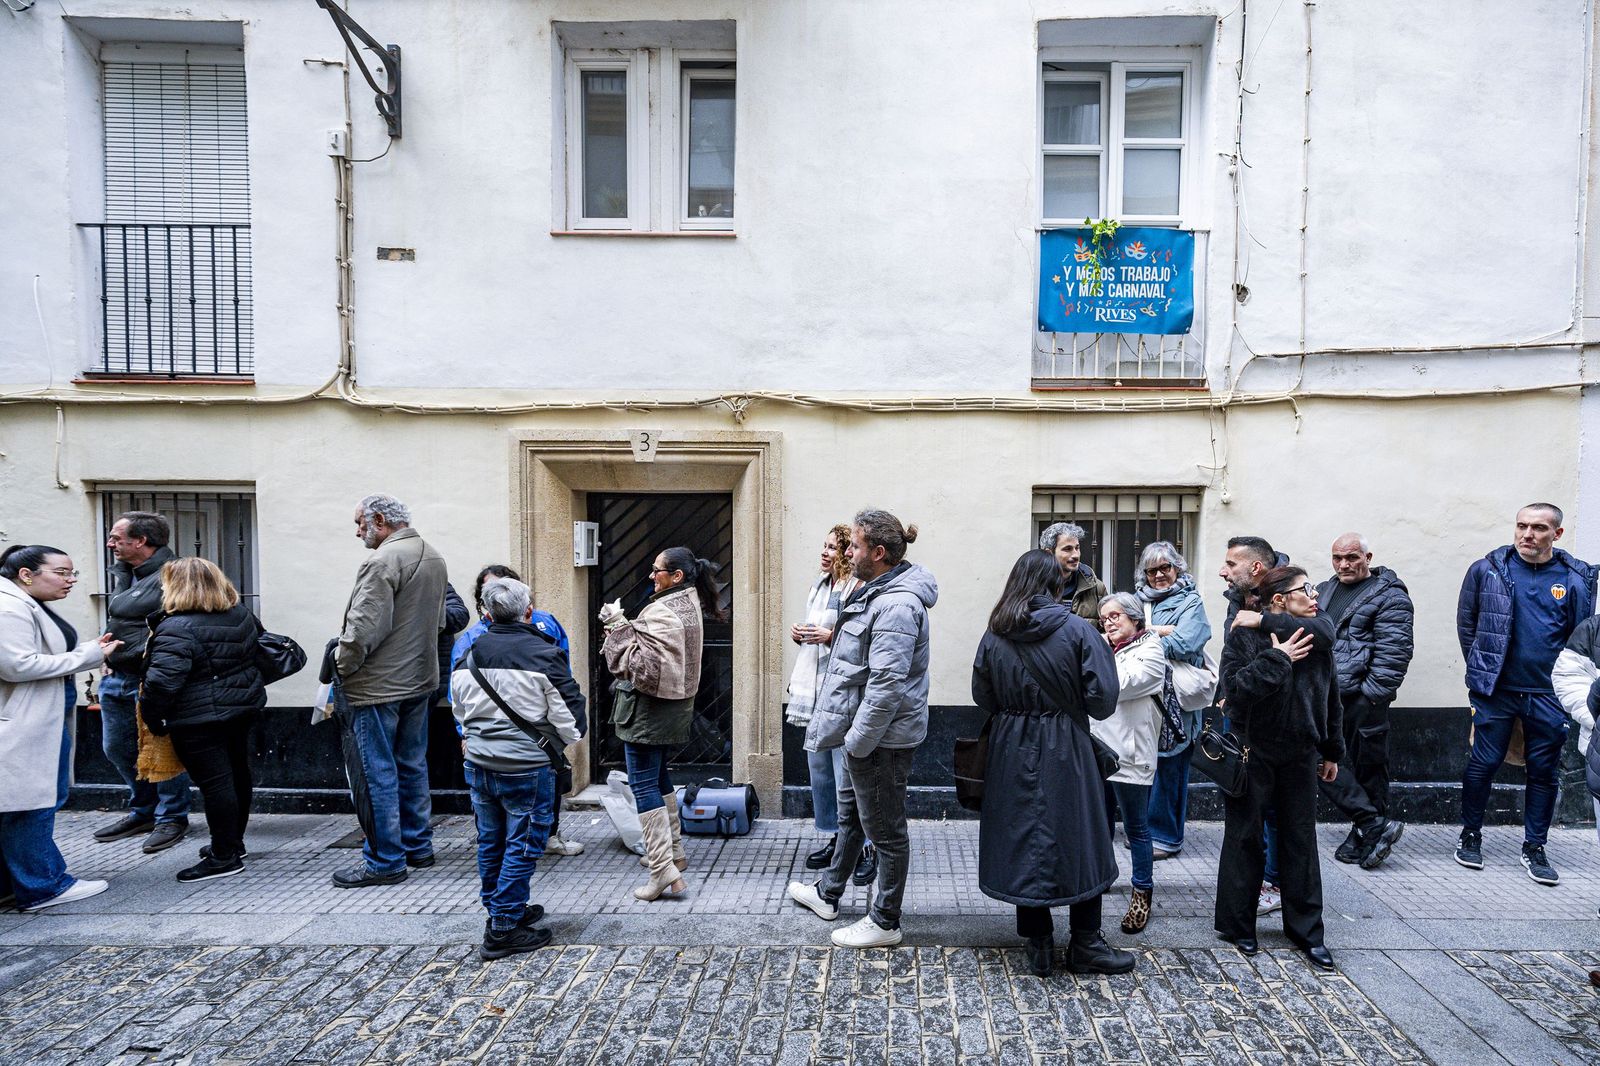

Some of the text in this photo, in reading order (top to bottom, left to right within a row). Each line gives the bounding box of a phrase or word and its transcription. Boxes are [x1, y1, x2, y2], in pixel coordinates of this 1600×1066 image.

[1063, 265, 1072, 281] Y
[1120, 266, 1171, 282] TRABAJO
[1066, 282, 1075, 297] Y
[1108, 283, 1167, 299] CARNAVAL
[1095, 307, 1137, 323] RIVES
[640, 432, 650, 452] 3
